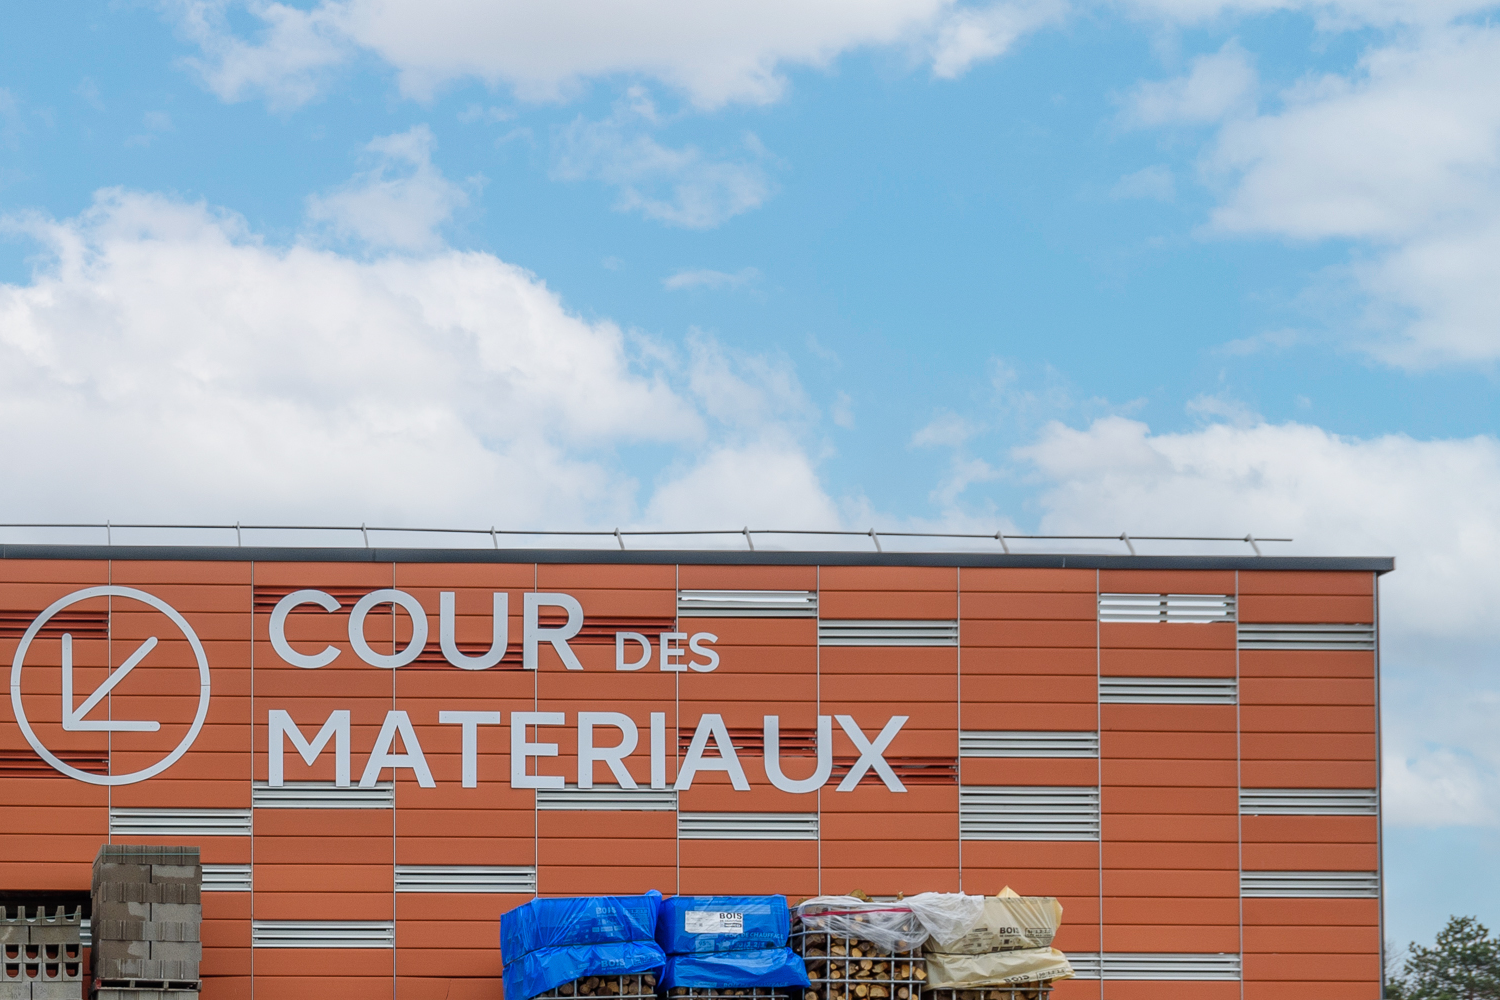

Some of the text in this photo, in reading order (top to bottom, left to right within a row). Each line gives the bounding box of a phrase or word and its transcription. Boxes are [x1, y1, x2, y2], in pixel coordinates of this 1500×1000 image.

[268, 588, 721, 673] COUR DES
[268, 709, 910, 794] MATERIAUX
[595, 907, 617, 915] BOIS
[719, 912, 743, 920] BOIS
